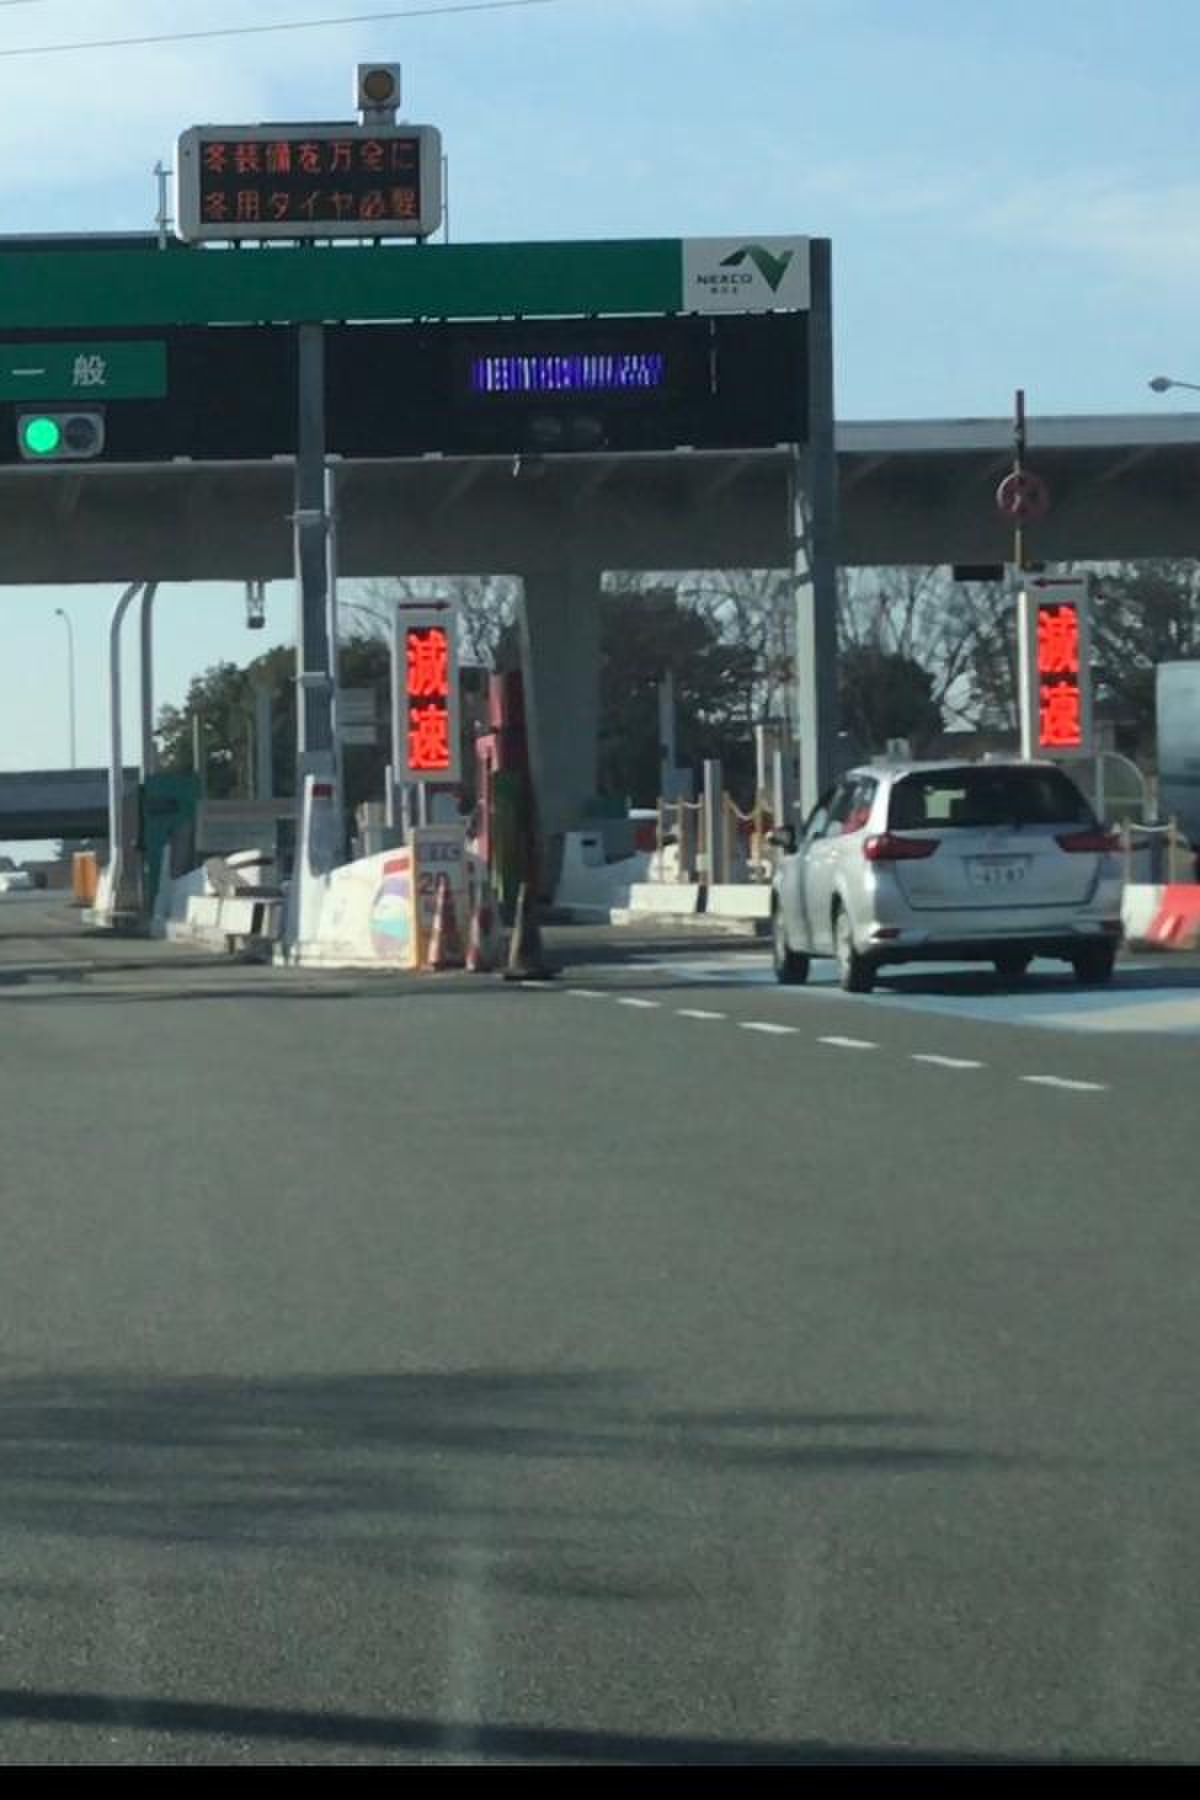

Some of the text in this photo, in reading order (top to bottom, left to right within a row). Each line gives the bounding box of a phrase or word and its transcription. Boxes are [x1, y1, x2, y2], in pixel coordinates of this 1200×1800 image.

[11, 353, 107, 386] 一般
[406, 629, 450, 770] 減速
[1038, 606, 1081, 747] 減速
